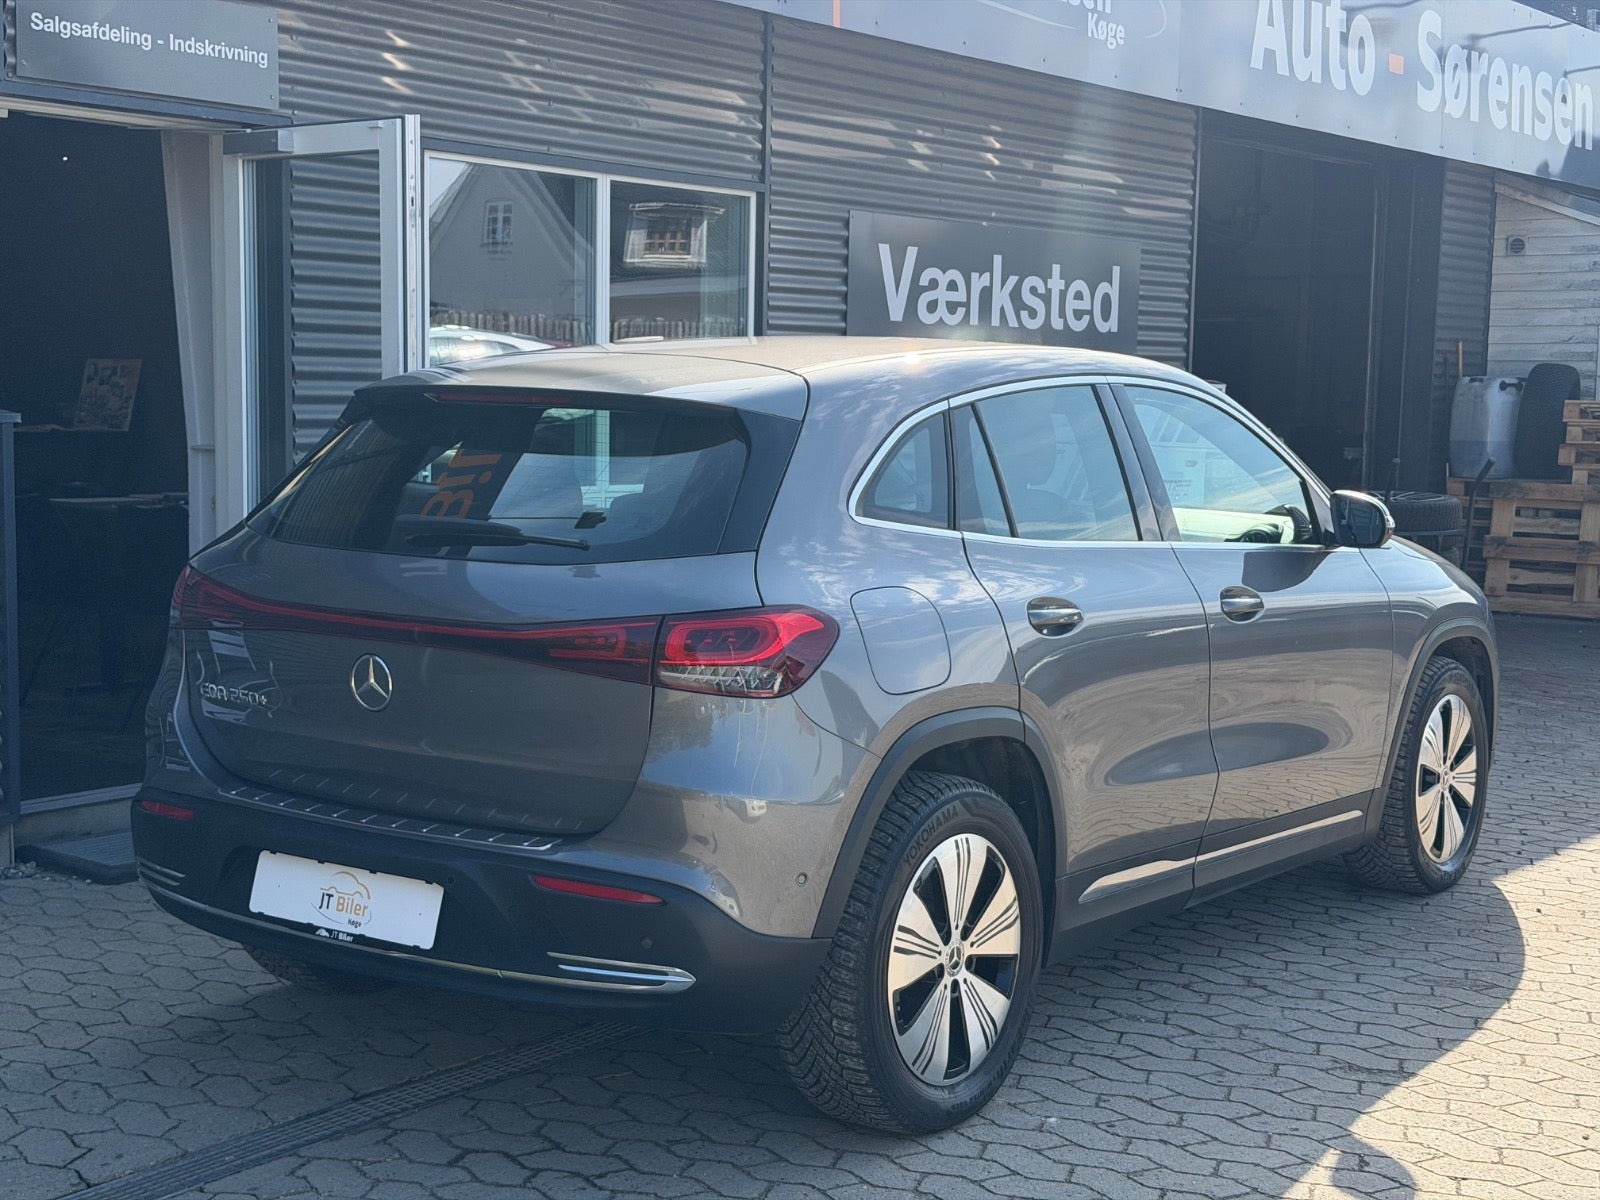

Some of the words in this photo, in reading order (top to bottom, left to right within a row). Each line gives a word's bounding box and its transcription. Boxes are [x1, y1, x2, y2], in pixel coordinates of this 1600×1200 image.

[30, 11, 152, 51] Salgsafdeling
[169, 33, 268, 68] Indskrivning
[1087, 11, 1125, 49] Køge
[1250, 0, 1375, 96] Auto
[1416, 9, 1594, 151] Sørensen
[878, 243, 1121, 333] Værksted
[902, 804, 960, 867] YOKOHAMA
[319, 892, 334, 909] JT
[336, 896, 368, 917] Biler
[338, 932, 354, 942] Biler
